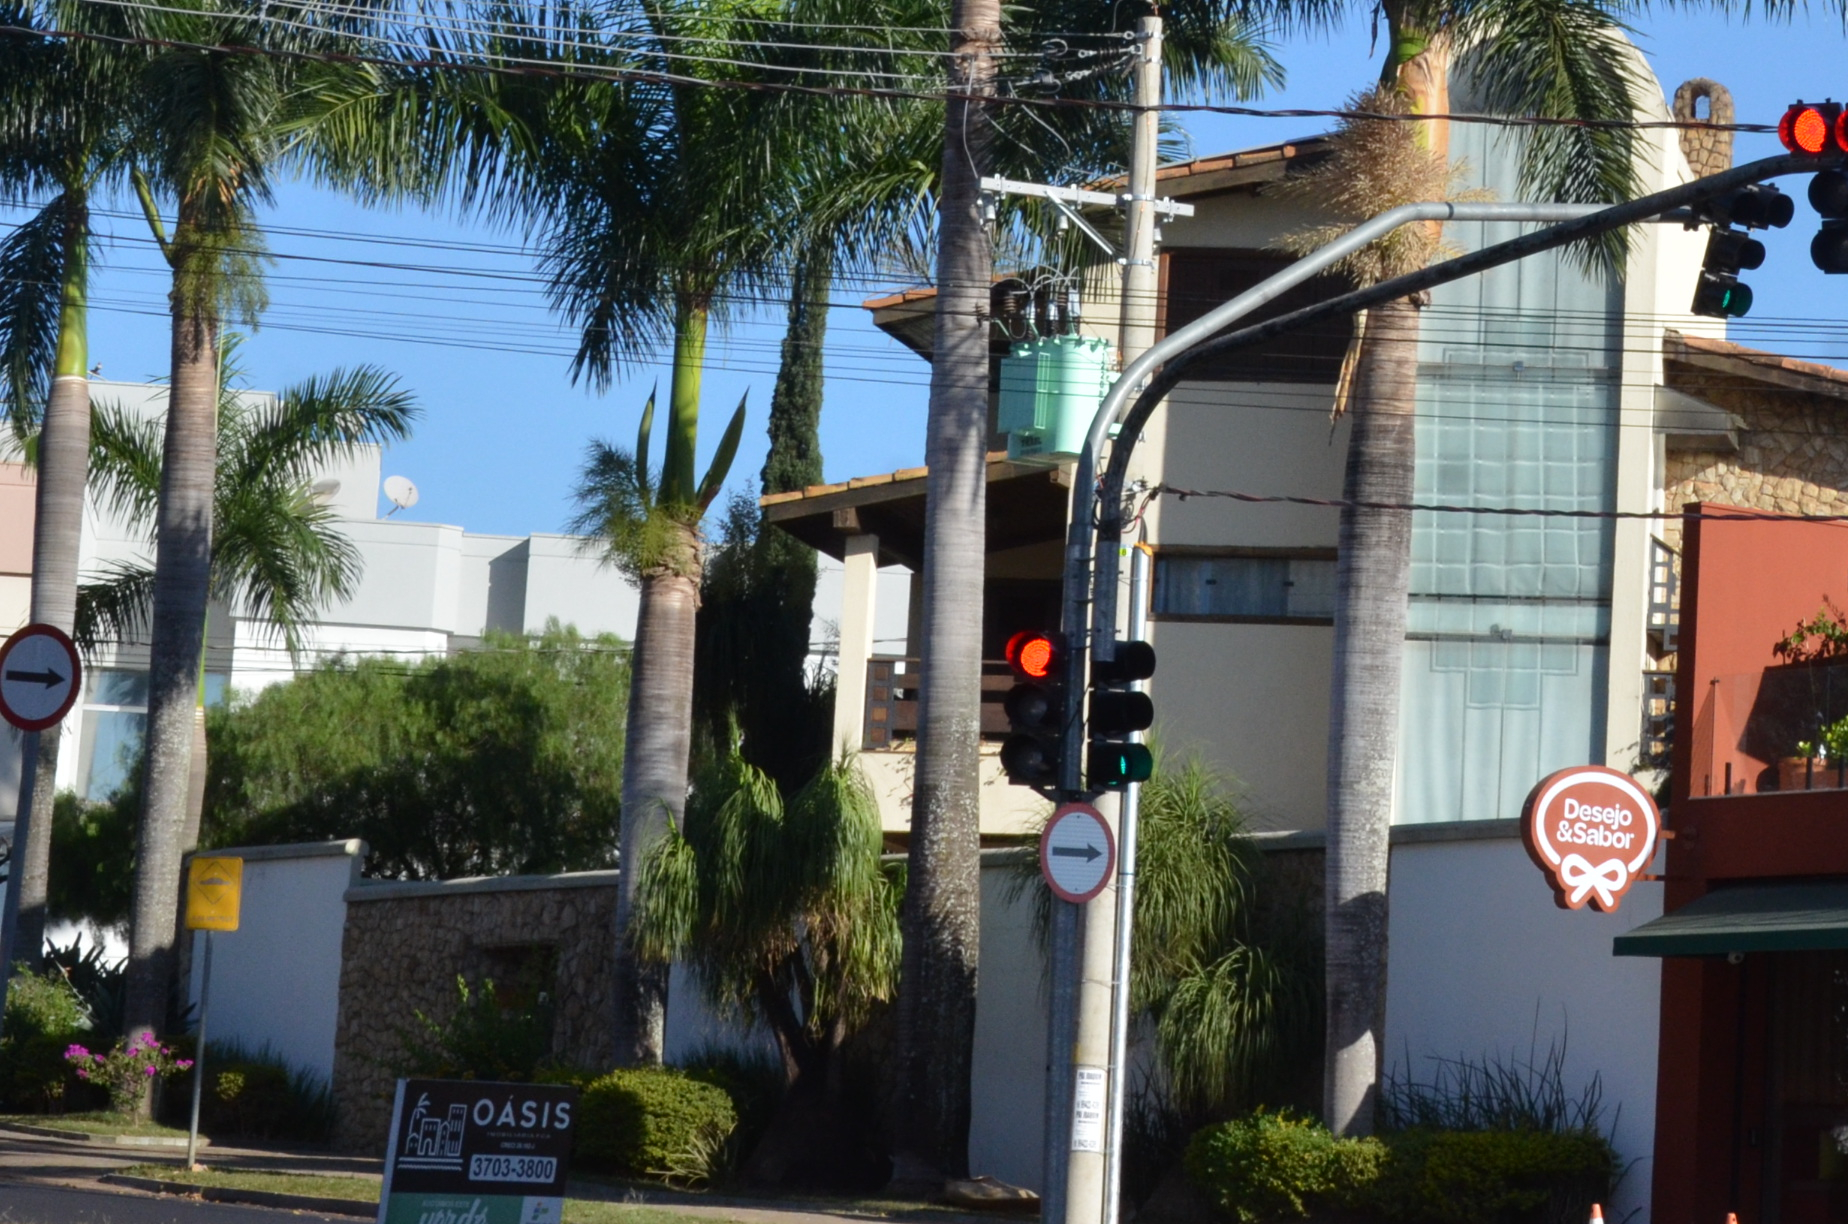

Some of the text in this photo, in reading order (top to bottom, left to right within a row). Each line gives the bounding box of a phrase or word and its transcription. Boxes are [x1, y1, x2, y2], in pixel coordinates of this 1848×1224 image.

[1563, 797, 1633, 830] Desejo
[1556, 820, 1635, 849] &Sabor
[472, 1094, 572, 1130] OÁSIS
[472, 1156, 554, 1180] 3703-3800
